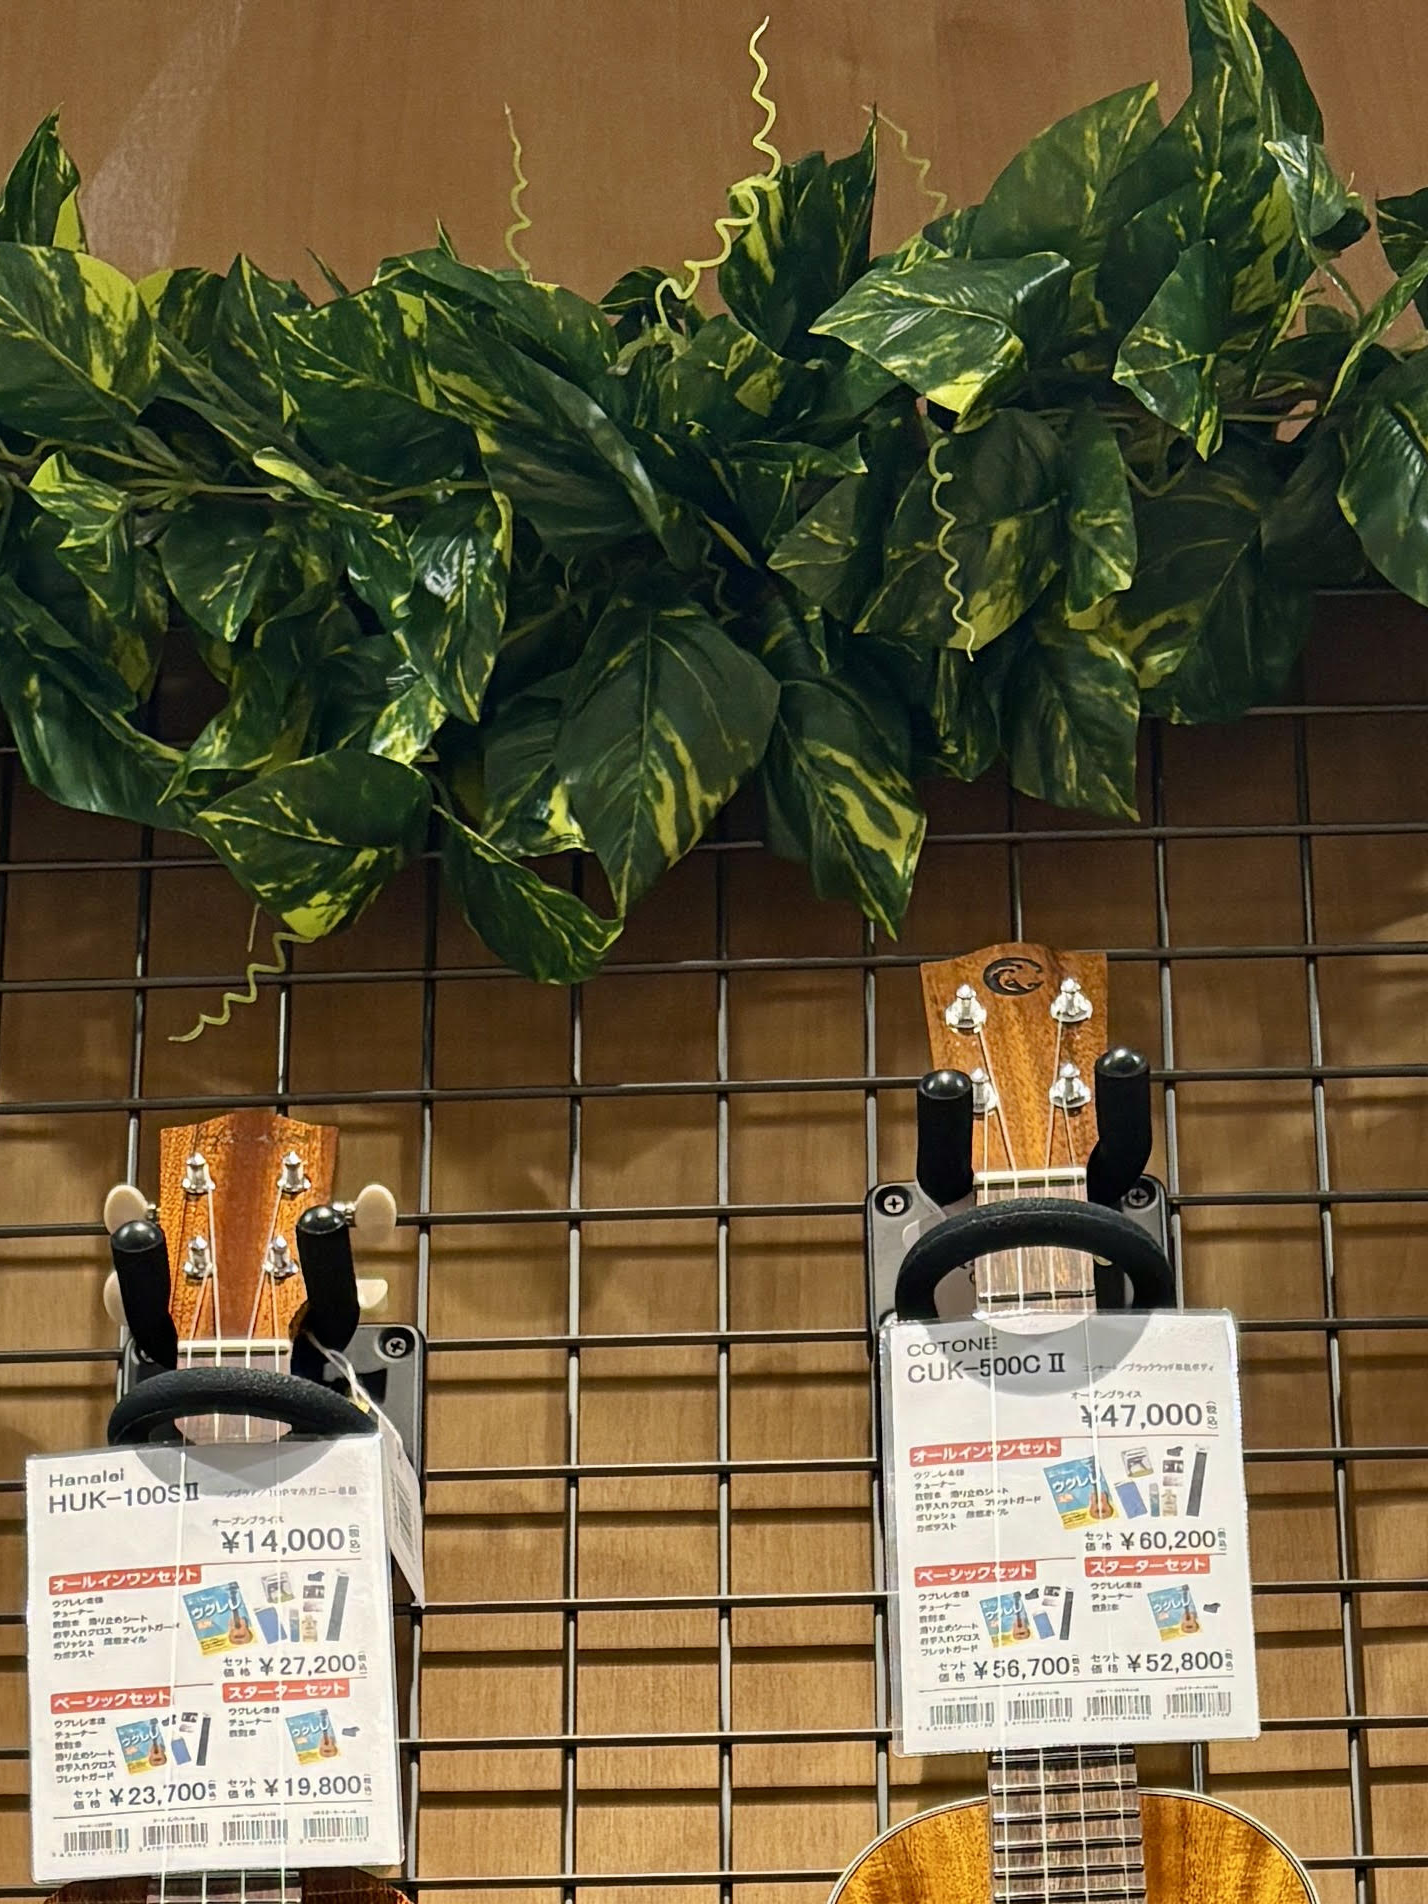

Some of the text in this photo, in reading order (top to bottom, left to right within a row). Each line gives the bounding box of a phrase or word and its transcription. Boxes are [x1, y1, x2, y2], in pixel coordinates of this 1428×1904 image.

[907, 1336, 997, 1356] COTONE
[1081, 1400, 1203, 1431] ¥47,000
[912, 1441, 1057, 1463] オールインワンセット
[221, 1524, 345, 1557] ¥14,000
[1120, 1527, 1216, 1552] ¥60,200
[918, 1562, 1033, 1584] ベーシックセット
[1089, 1555, 1206, 1575] スターターセット
[51, 1569, 197, 1592] オールインワンセット
[258, 1652, 356, 1678] ¥27,200
[973, 1655, 1070, 1681] ¥56,700
[1127, 1649, 1224, 1675] ¥52,800
[227, 1680, 345, 1702] スターターセット
[109, 1781, 206, 1806] ¥23,700
[263, 1773, 362, 1799] ¥19,800
